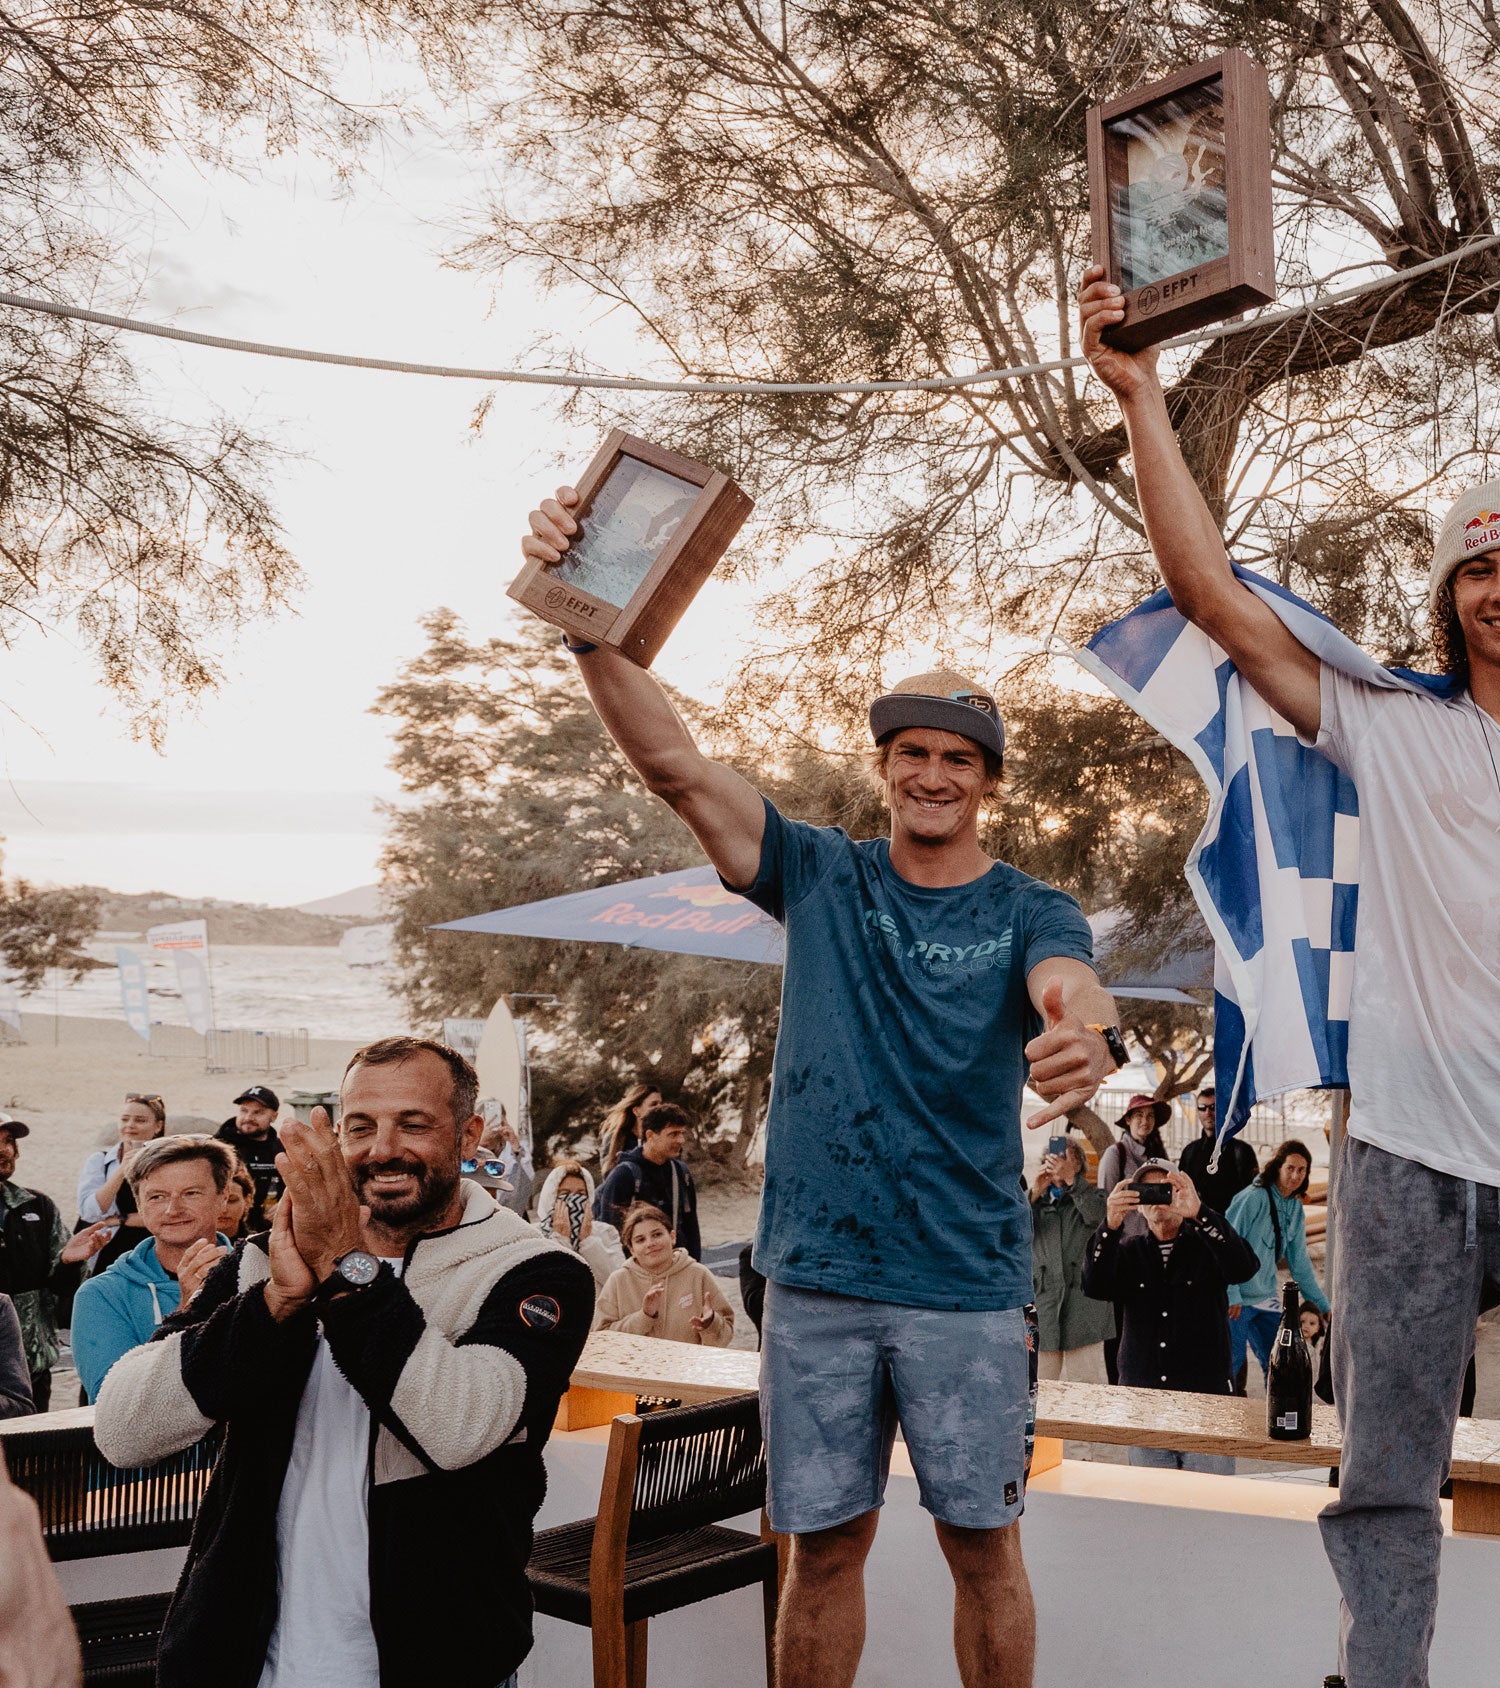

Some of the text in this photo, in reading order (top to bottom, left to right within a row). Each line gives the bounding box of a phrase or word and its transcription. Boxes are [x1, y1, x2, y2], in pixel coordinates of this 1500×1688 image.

[1163, 274, 1198, 298] EFPT
[1464, 532, 1488, 551] Red
[565, 597, 598, 618] EFPT
[590, 901, 763, 935] Red Bull
